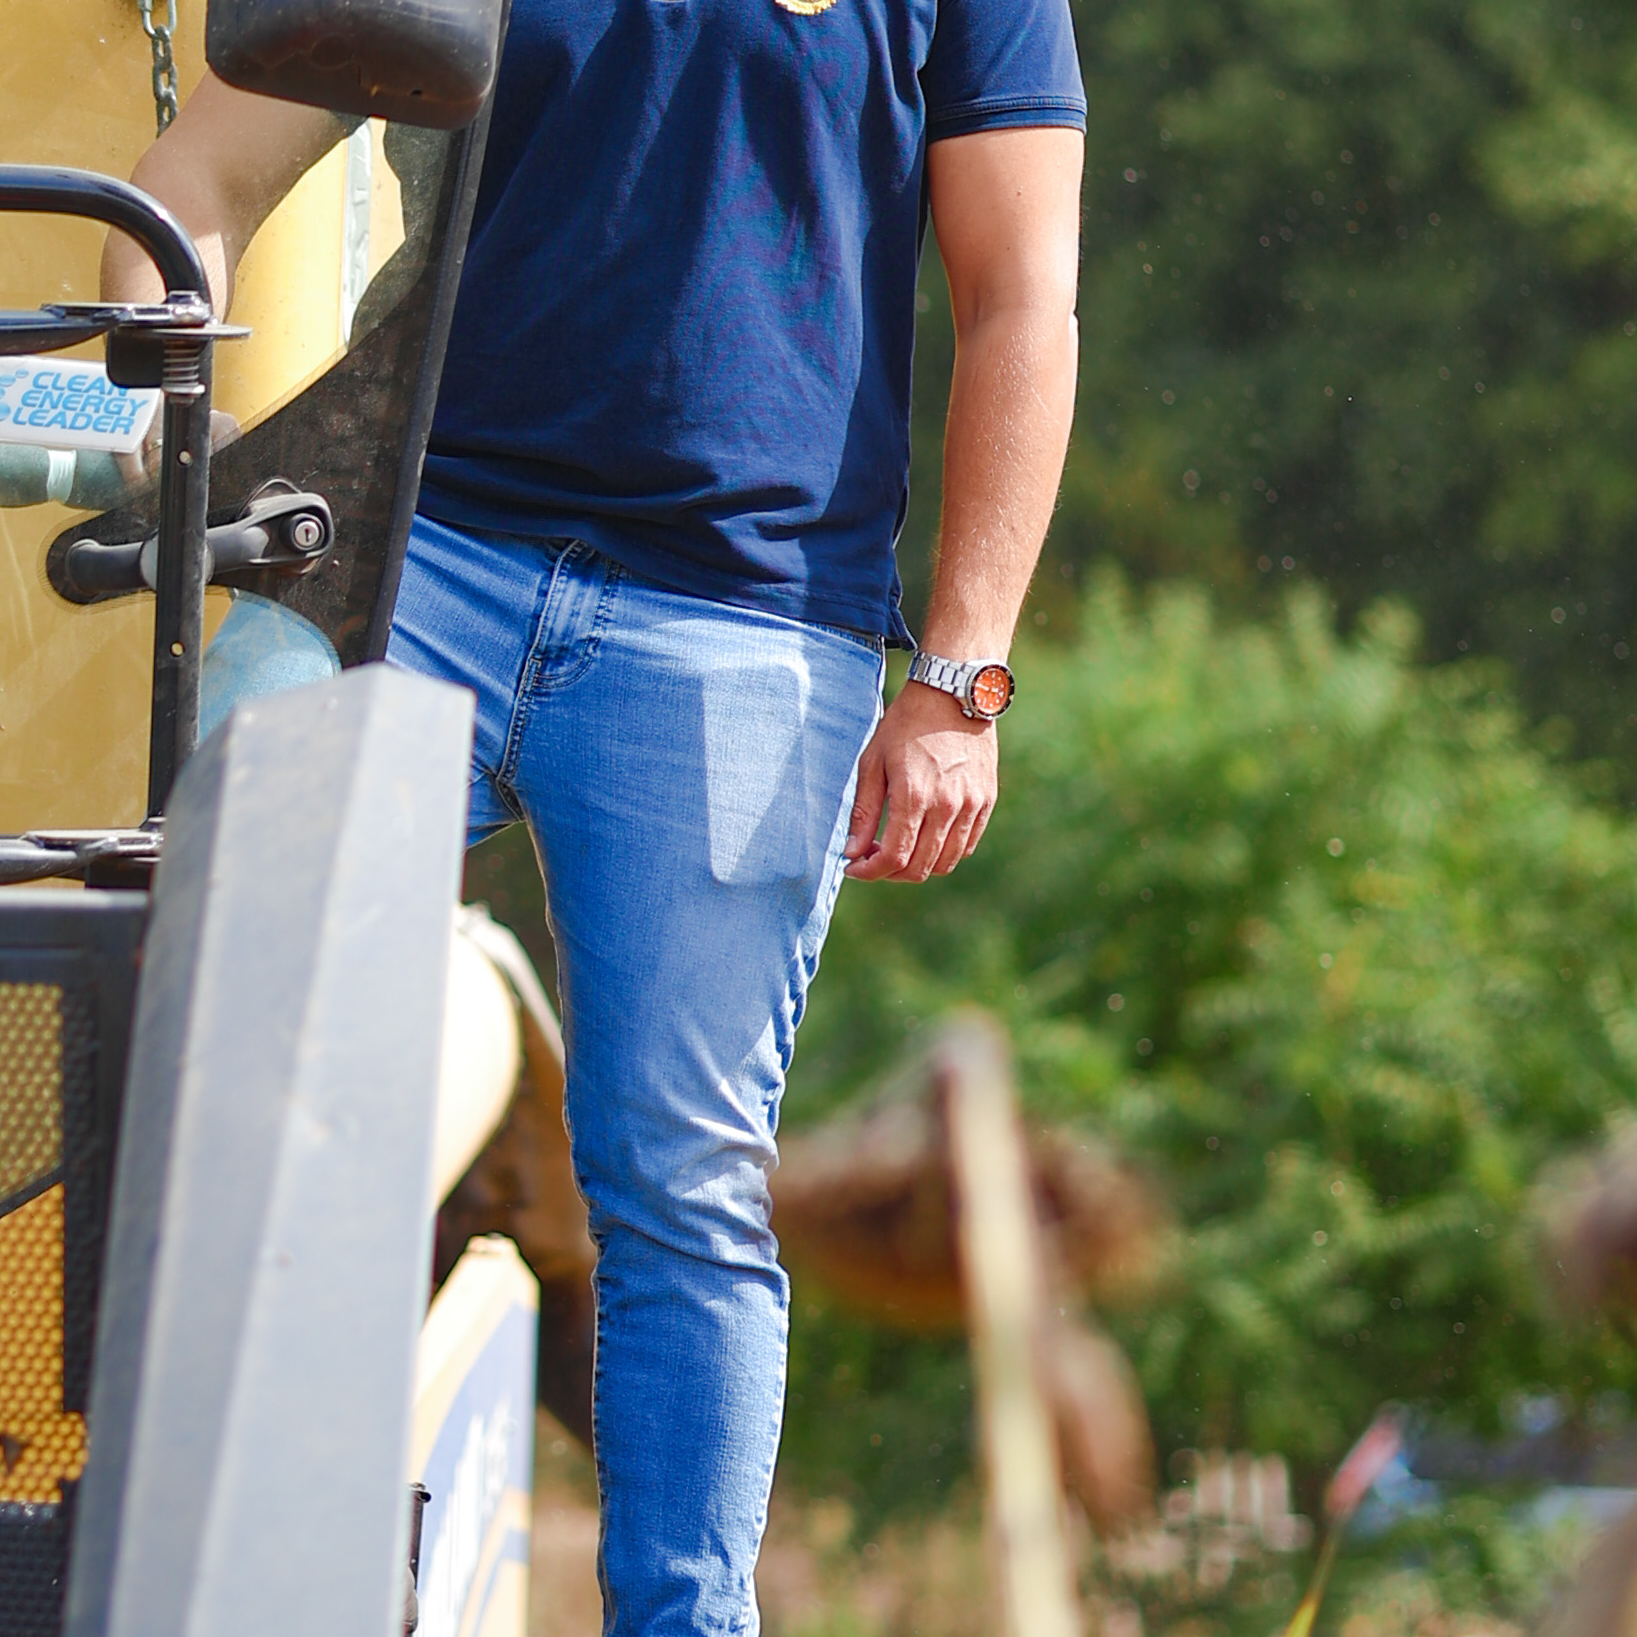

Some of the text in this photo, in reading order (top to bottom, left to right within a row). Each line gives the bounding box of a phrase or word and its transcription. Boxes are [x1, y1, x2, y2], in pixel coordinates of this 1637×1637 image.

[33, 371, 130, 396] CLEAN
[21, 389, 149, 416] ENERGY
[13, 407, 134, 434] LEADER
